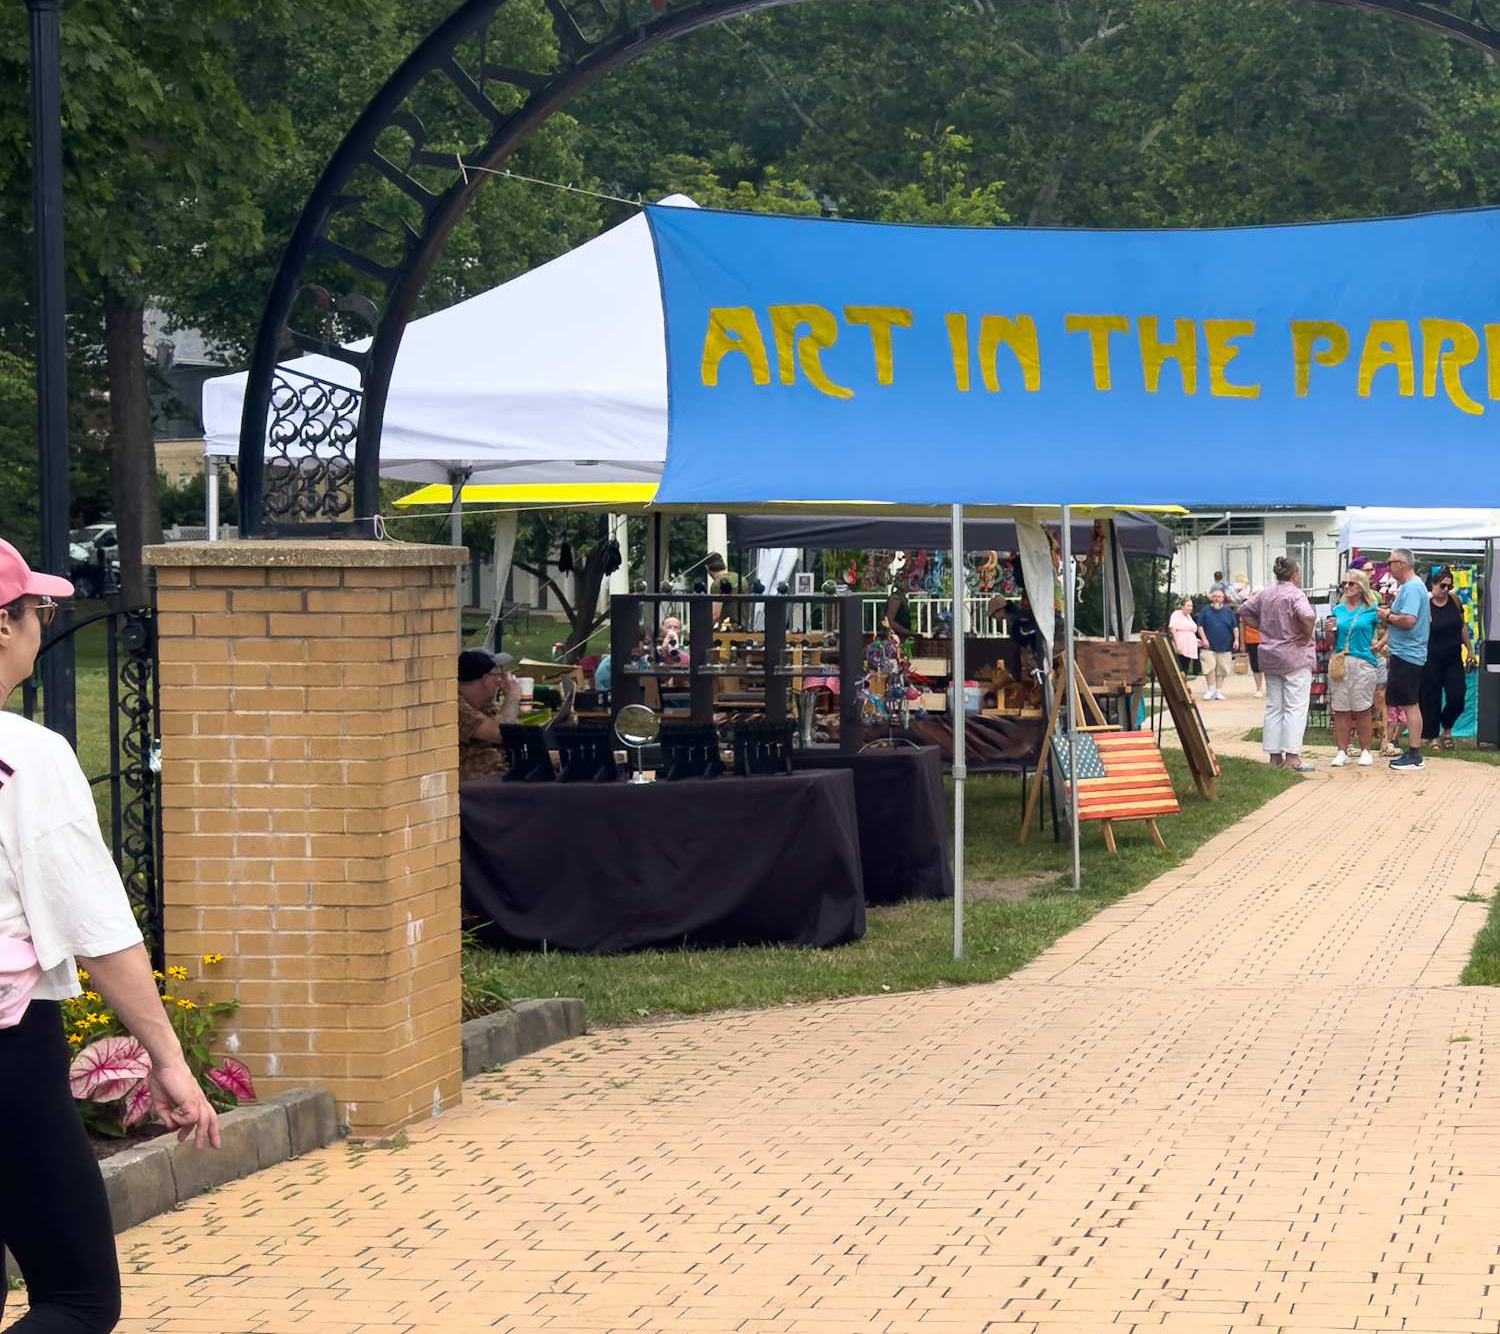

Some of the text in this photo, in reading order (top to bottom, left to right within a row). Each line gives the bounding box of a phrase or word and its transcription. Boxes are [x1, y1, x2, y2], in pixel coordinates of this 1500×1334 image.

[700, 304, 912, 399] ART
[944, 312, 1041, 392] IN
[1064, 314, 1261, 399] THE
